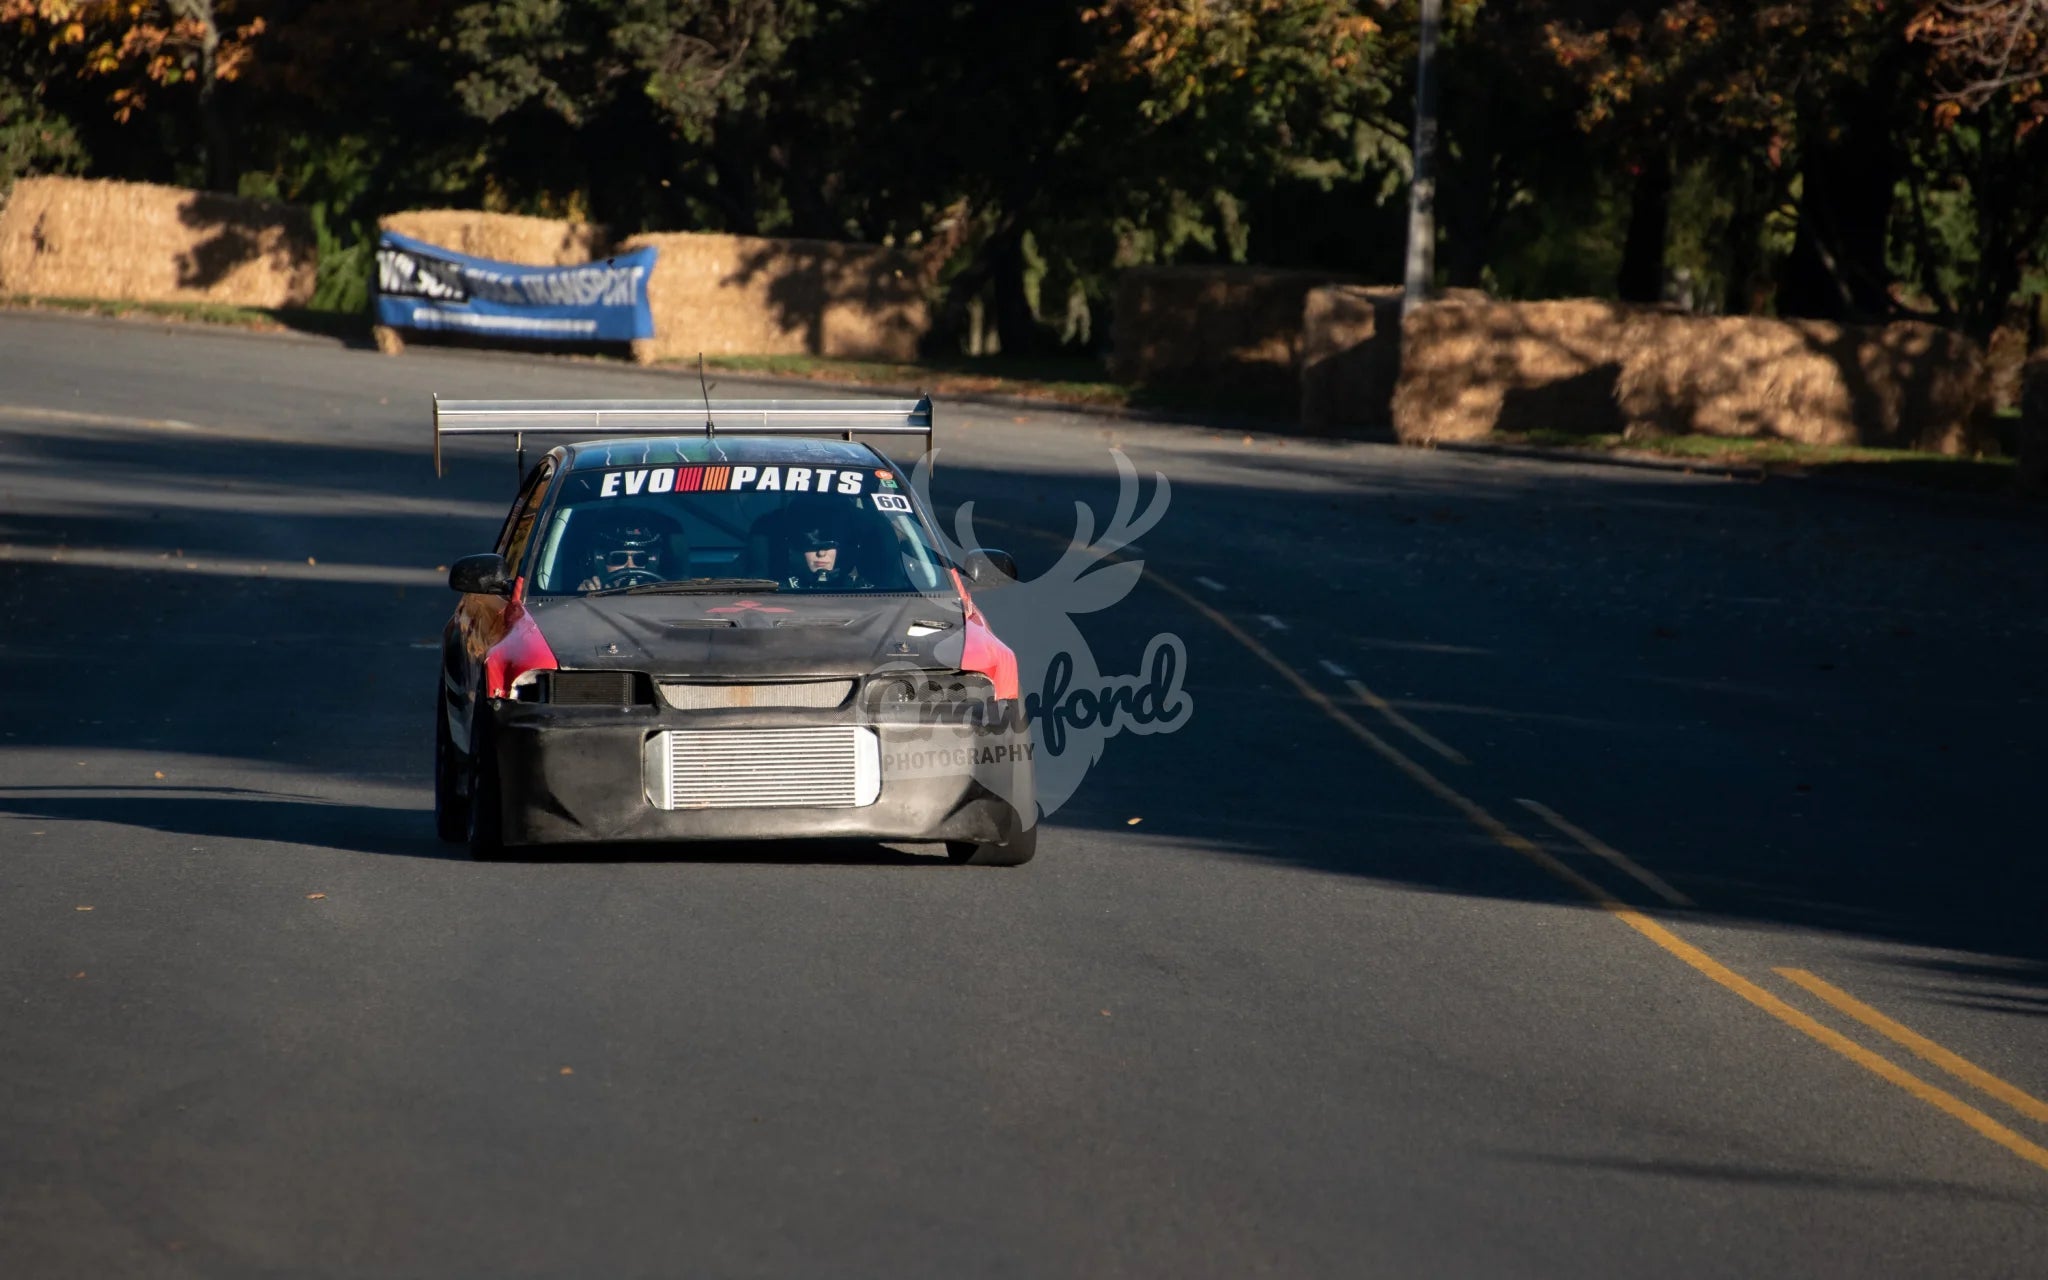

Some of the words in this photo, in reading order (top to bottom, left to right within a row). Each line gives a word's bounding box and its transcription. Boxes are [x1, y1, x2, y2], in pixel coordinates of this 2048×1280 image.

[521, 266, 645, 307] TRANSPORT
[600, 467, 676, 498] EVO
[729, 466, 864, 495] PARTS
[877, 495, 908, 510] 60
